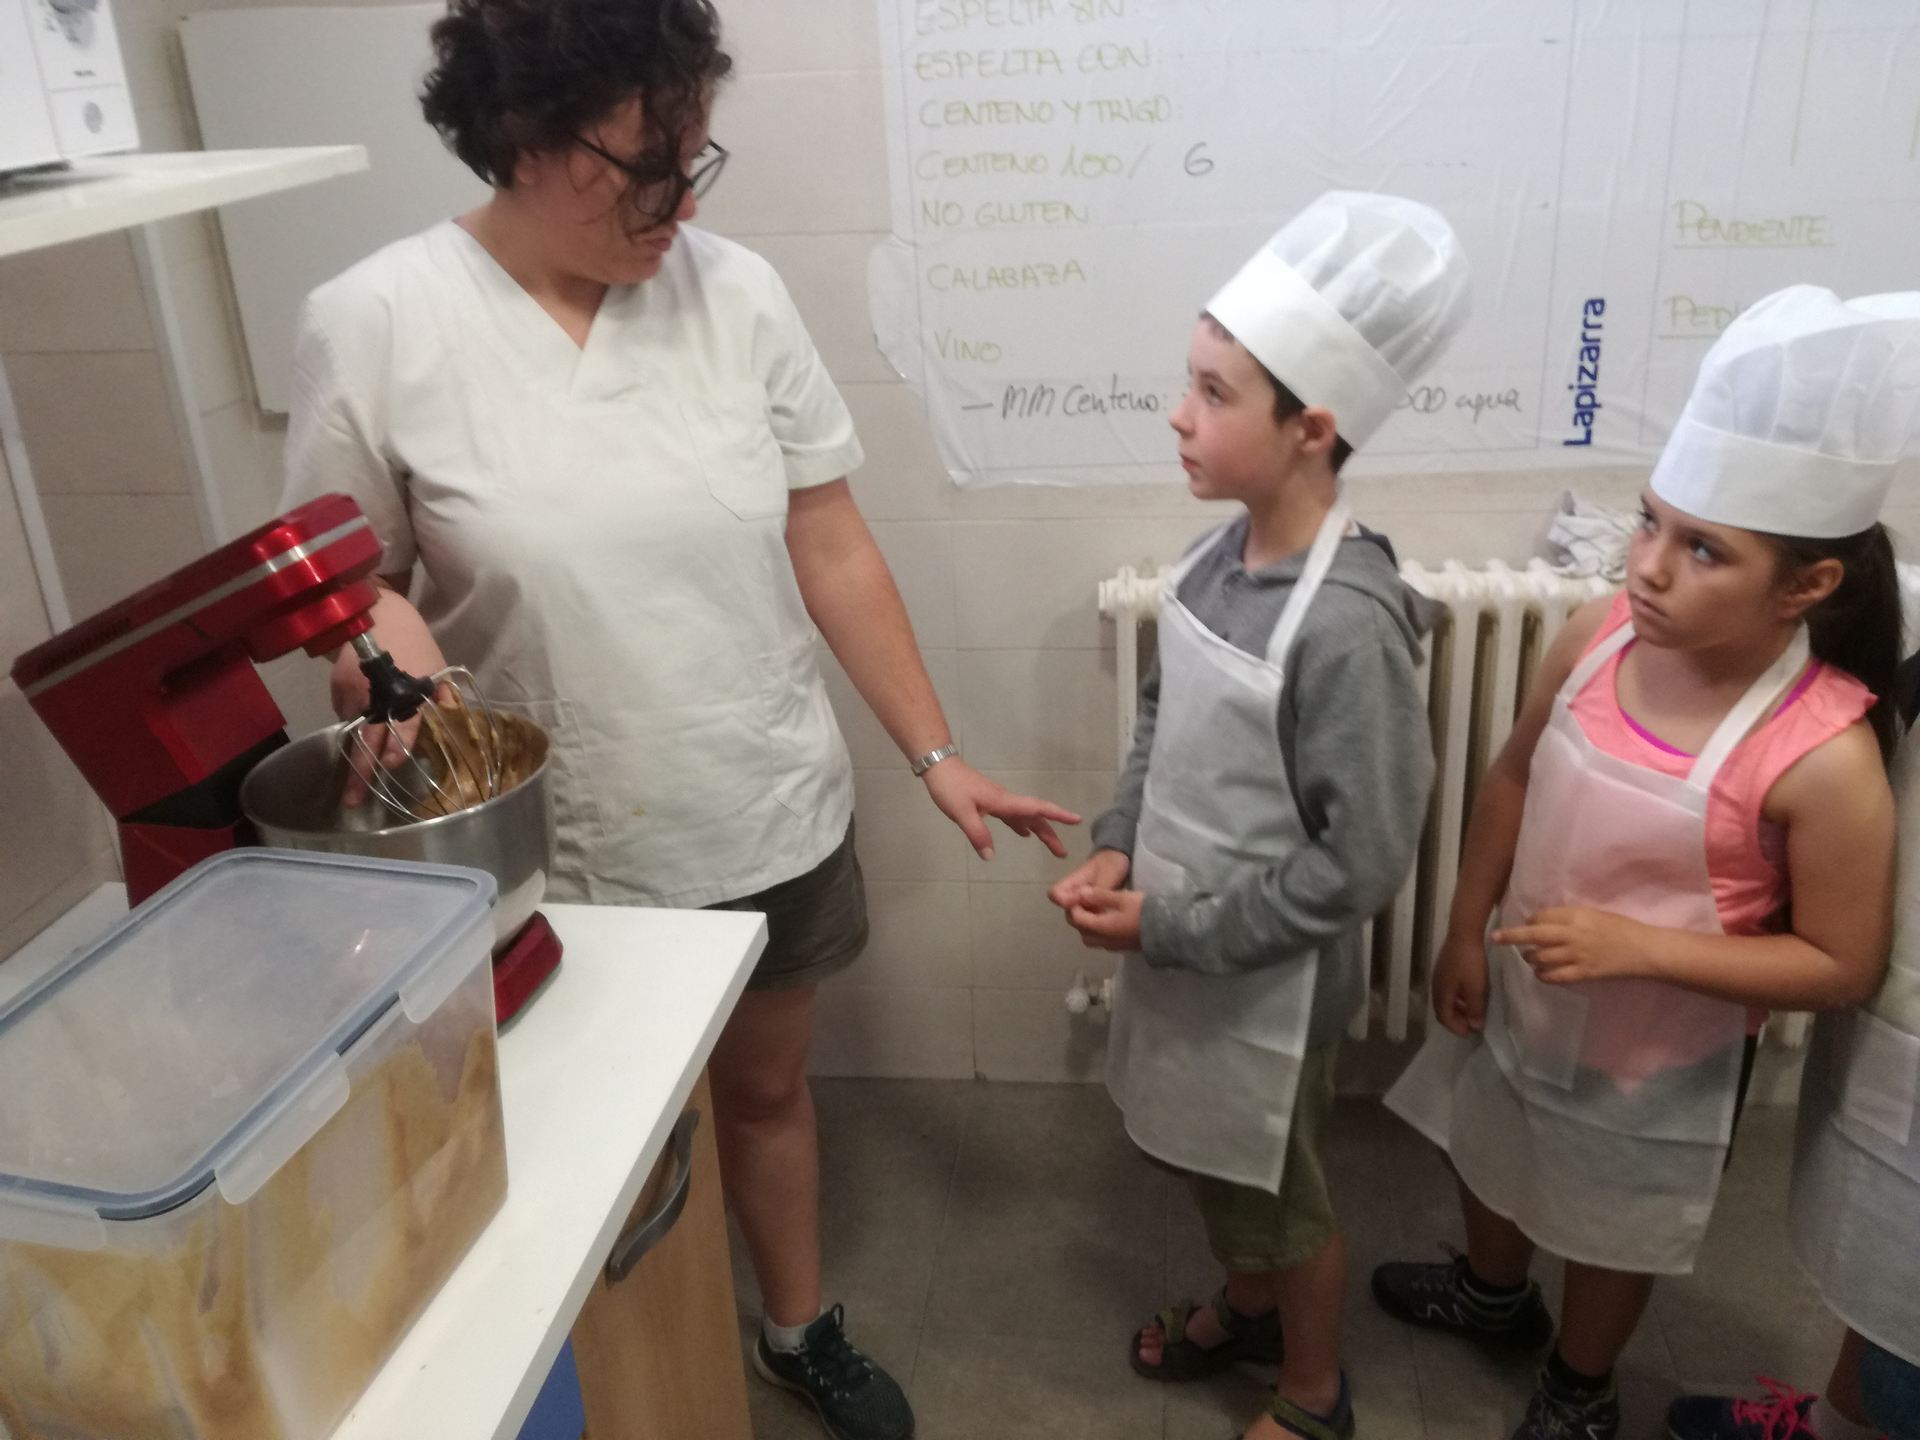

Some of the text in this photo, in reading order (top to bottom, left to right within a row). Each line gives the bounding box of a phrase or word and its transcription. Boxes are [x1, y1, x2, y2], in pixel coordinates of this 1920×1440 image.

[914, 0, 1056, 36] ESPELTA
[915, 39, 1151, 82] ESPELTA CON
[919, 95, 1172, 129] CENTENO Y TRIGO
[1182, 141, 1216, 177] 6
[920, 199, 1090, 227] NO GLUTEN
[926, 259, 1087, 292] CALABAZA
[933, 328, 1002, 363] VINO
[1563, 296, 1606, 447] Lapizarra
